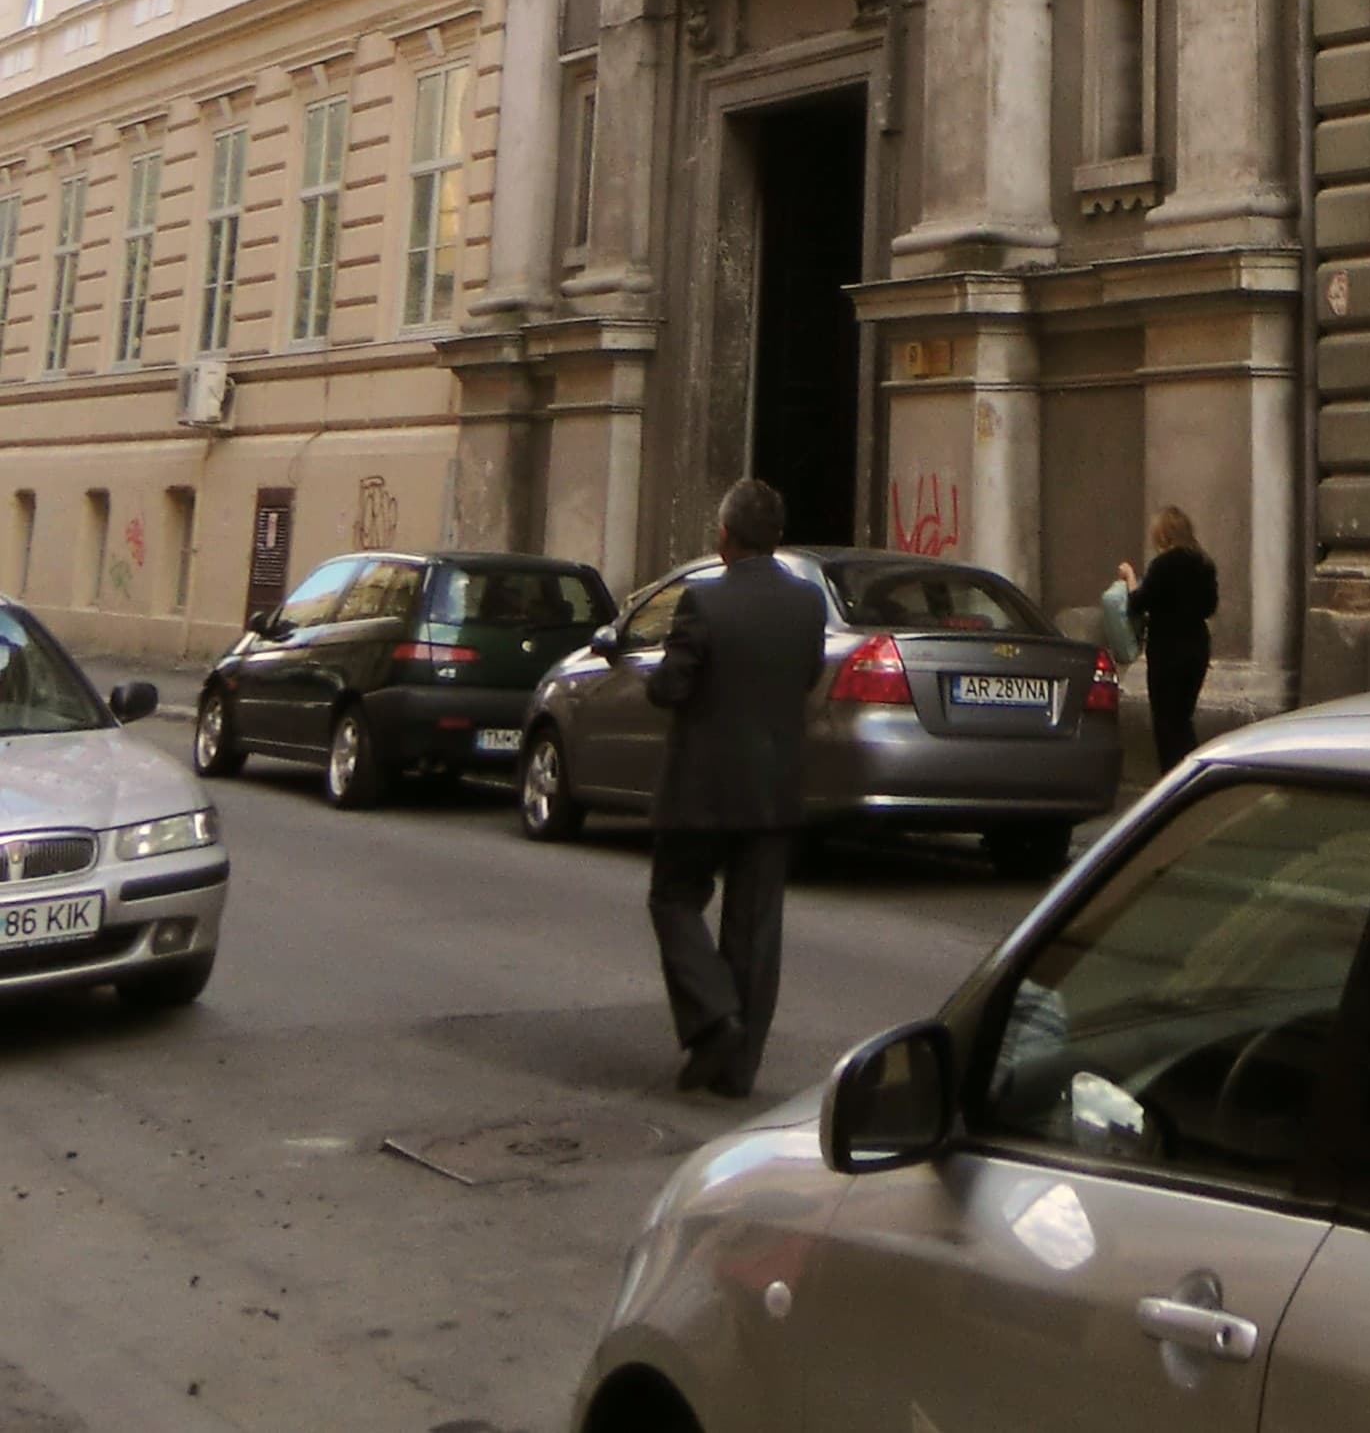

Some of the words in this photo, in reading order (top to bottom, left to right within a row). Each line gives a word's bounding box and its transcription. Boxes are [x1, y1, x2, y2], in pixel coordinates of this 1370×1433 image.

[965, 678, 990, 698] AR
[5, 908, 37, 936] 86
[46, 900, 91, 933] KIK
